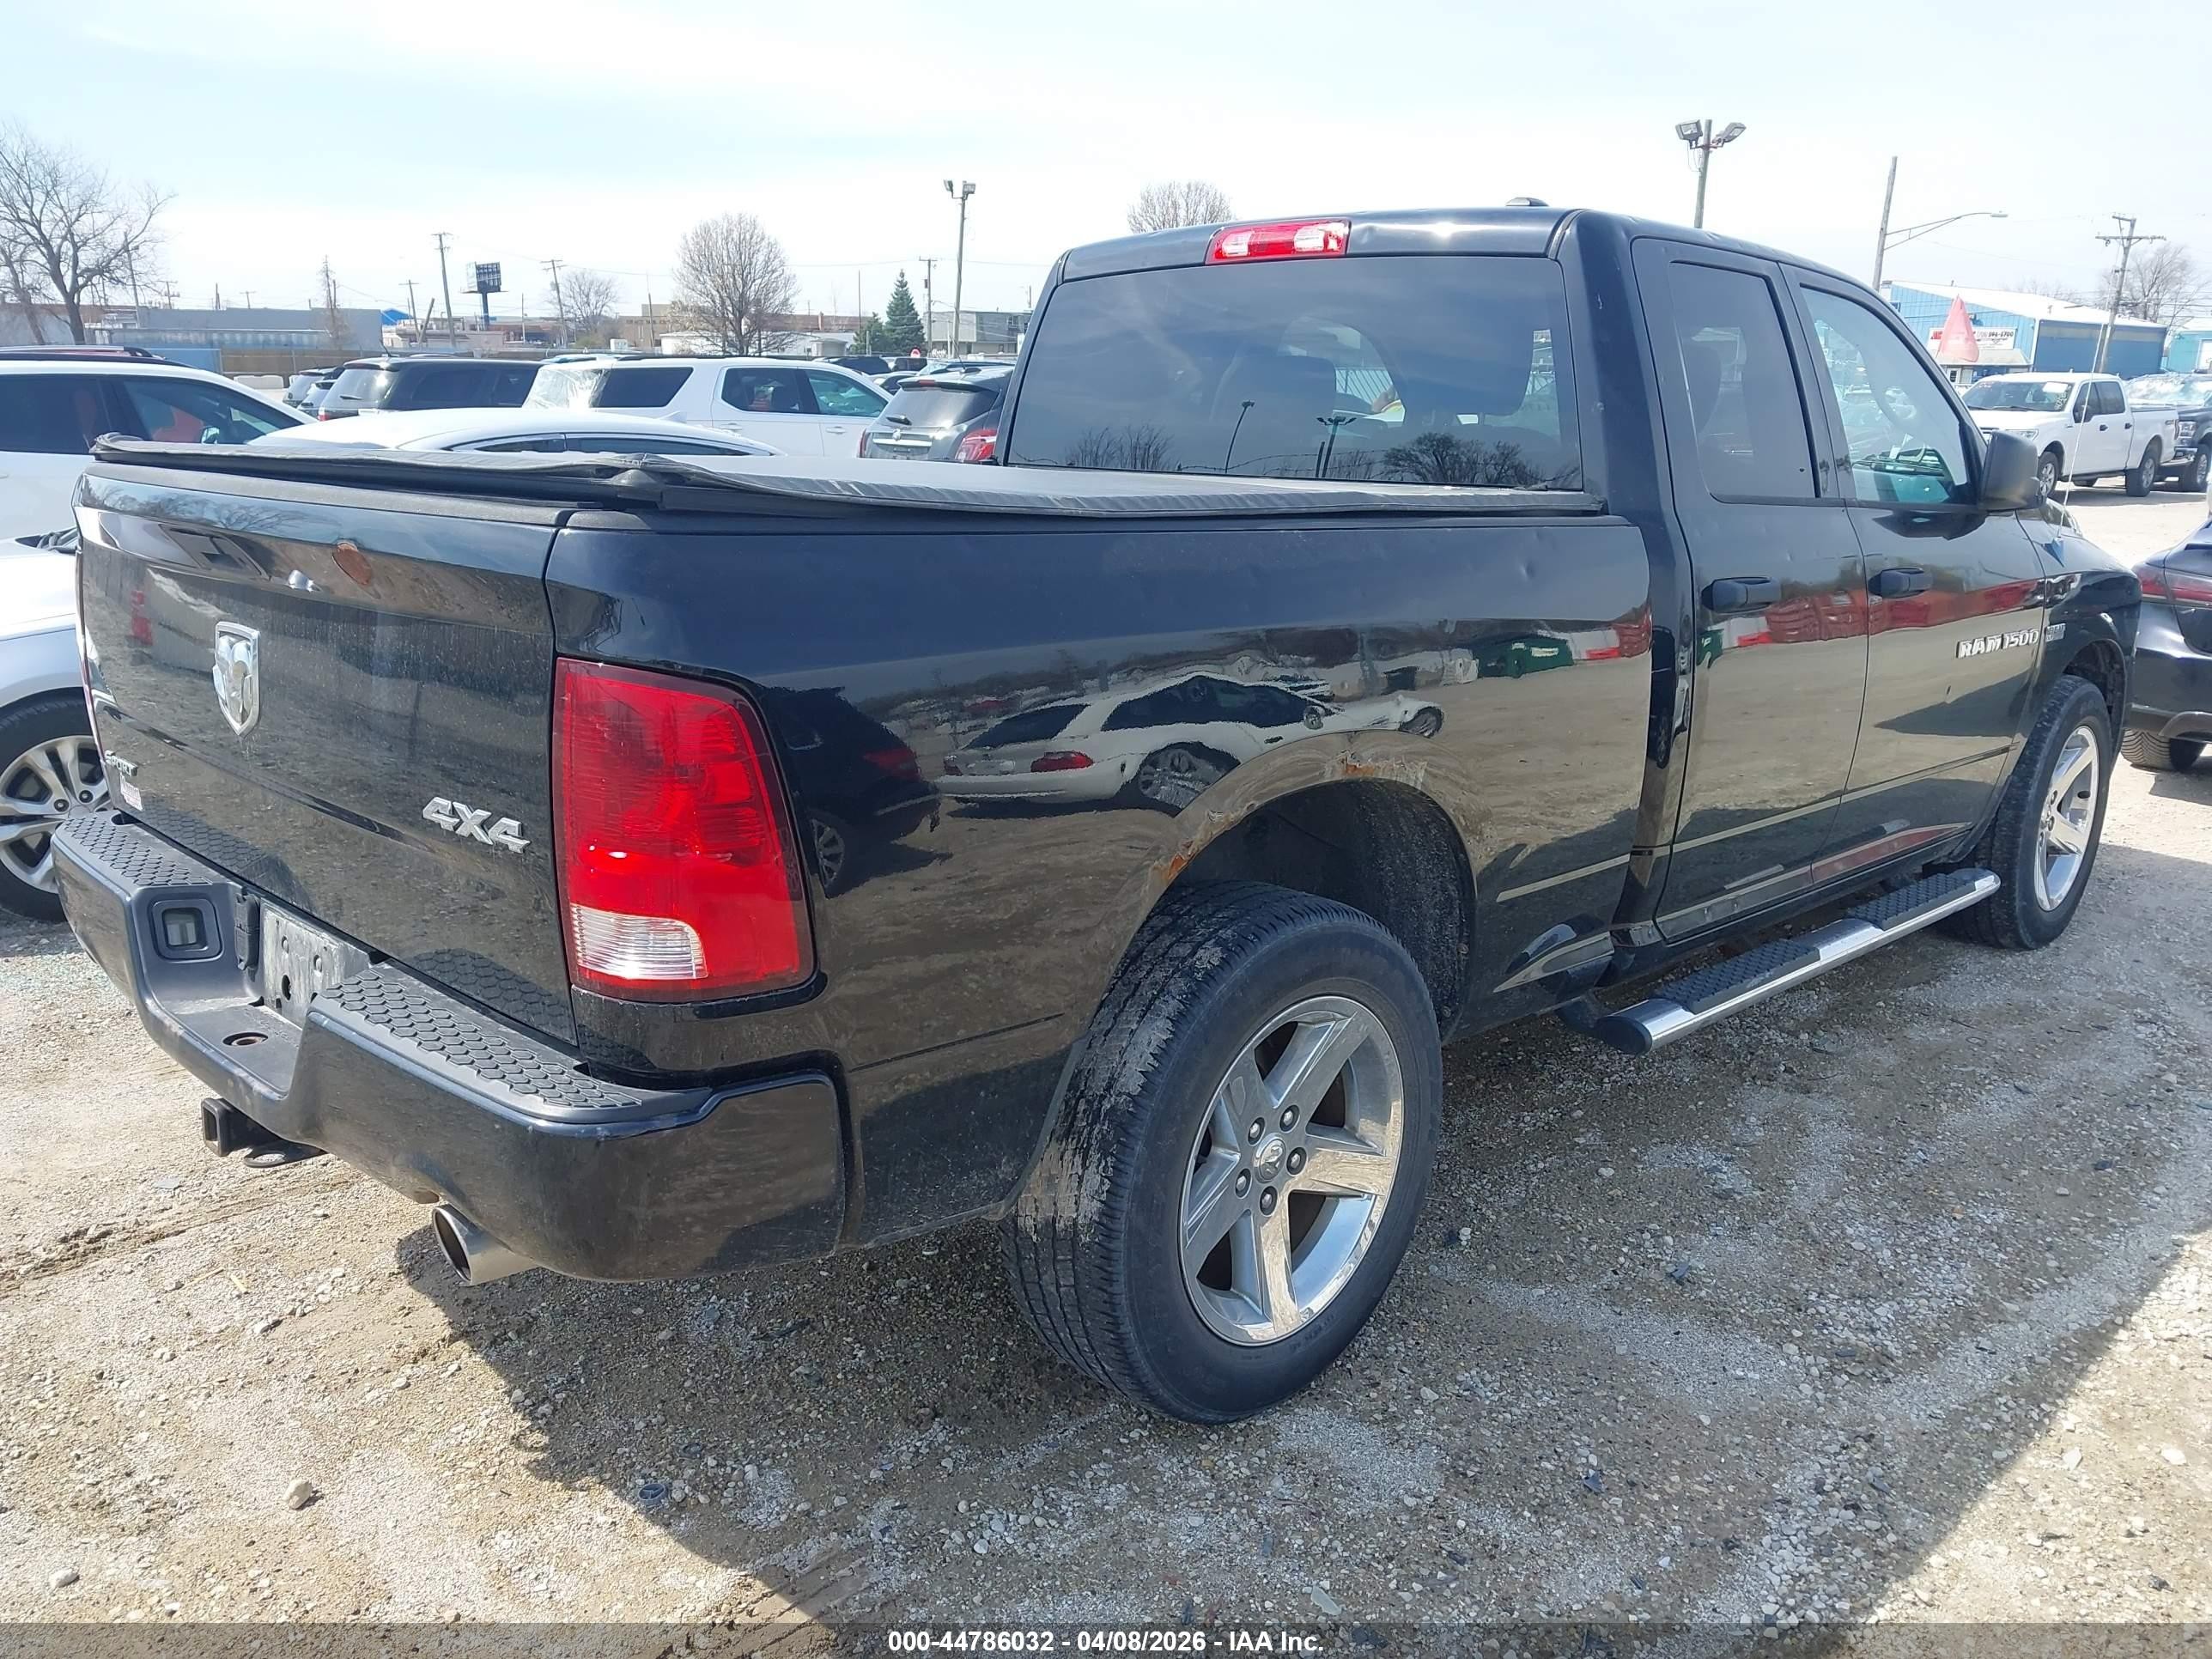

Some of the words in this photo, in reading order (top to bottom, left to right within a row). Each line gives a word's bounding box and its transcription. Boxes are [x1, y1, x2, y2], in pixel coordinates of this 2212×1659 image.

[1957, 634, 2003, 659] RAM
[2002, 628, 2039, 650] 1500
[104, 750, 137, 777] SPORT
